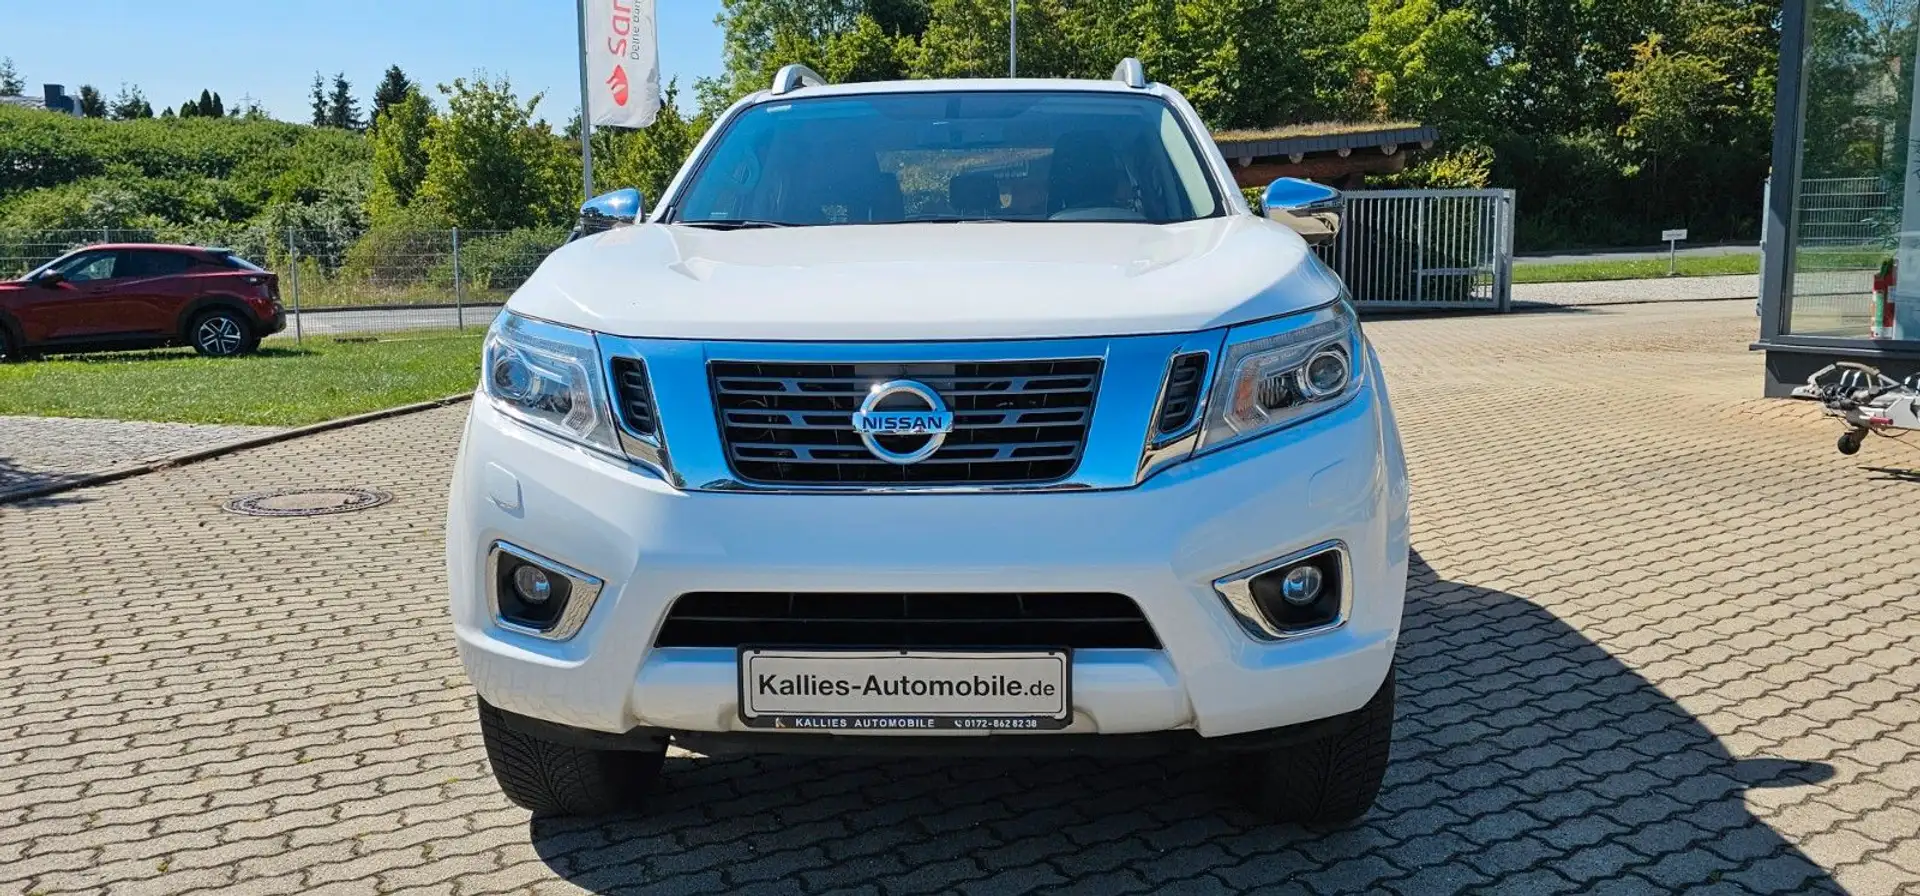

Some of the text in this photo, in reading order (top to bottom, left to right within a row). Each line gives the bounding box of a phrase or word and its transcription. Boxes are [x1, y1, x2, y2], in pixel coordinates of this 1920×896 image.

[862, 416, 942, 430] NISSAN
[758, 674, 1055, 696] Kallies-Automobile.de
[795, 718, 848, 728] KALLIES
[854, 718, 935, 728] AUTOMOBILE
